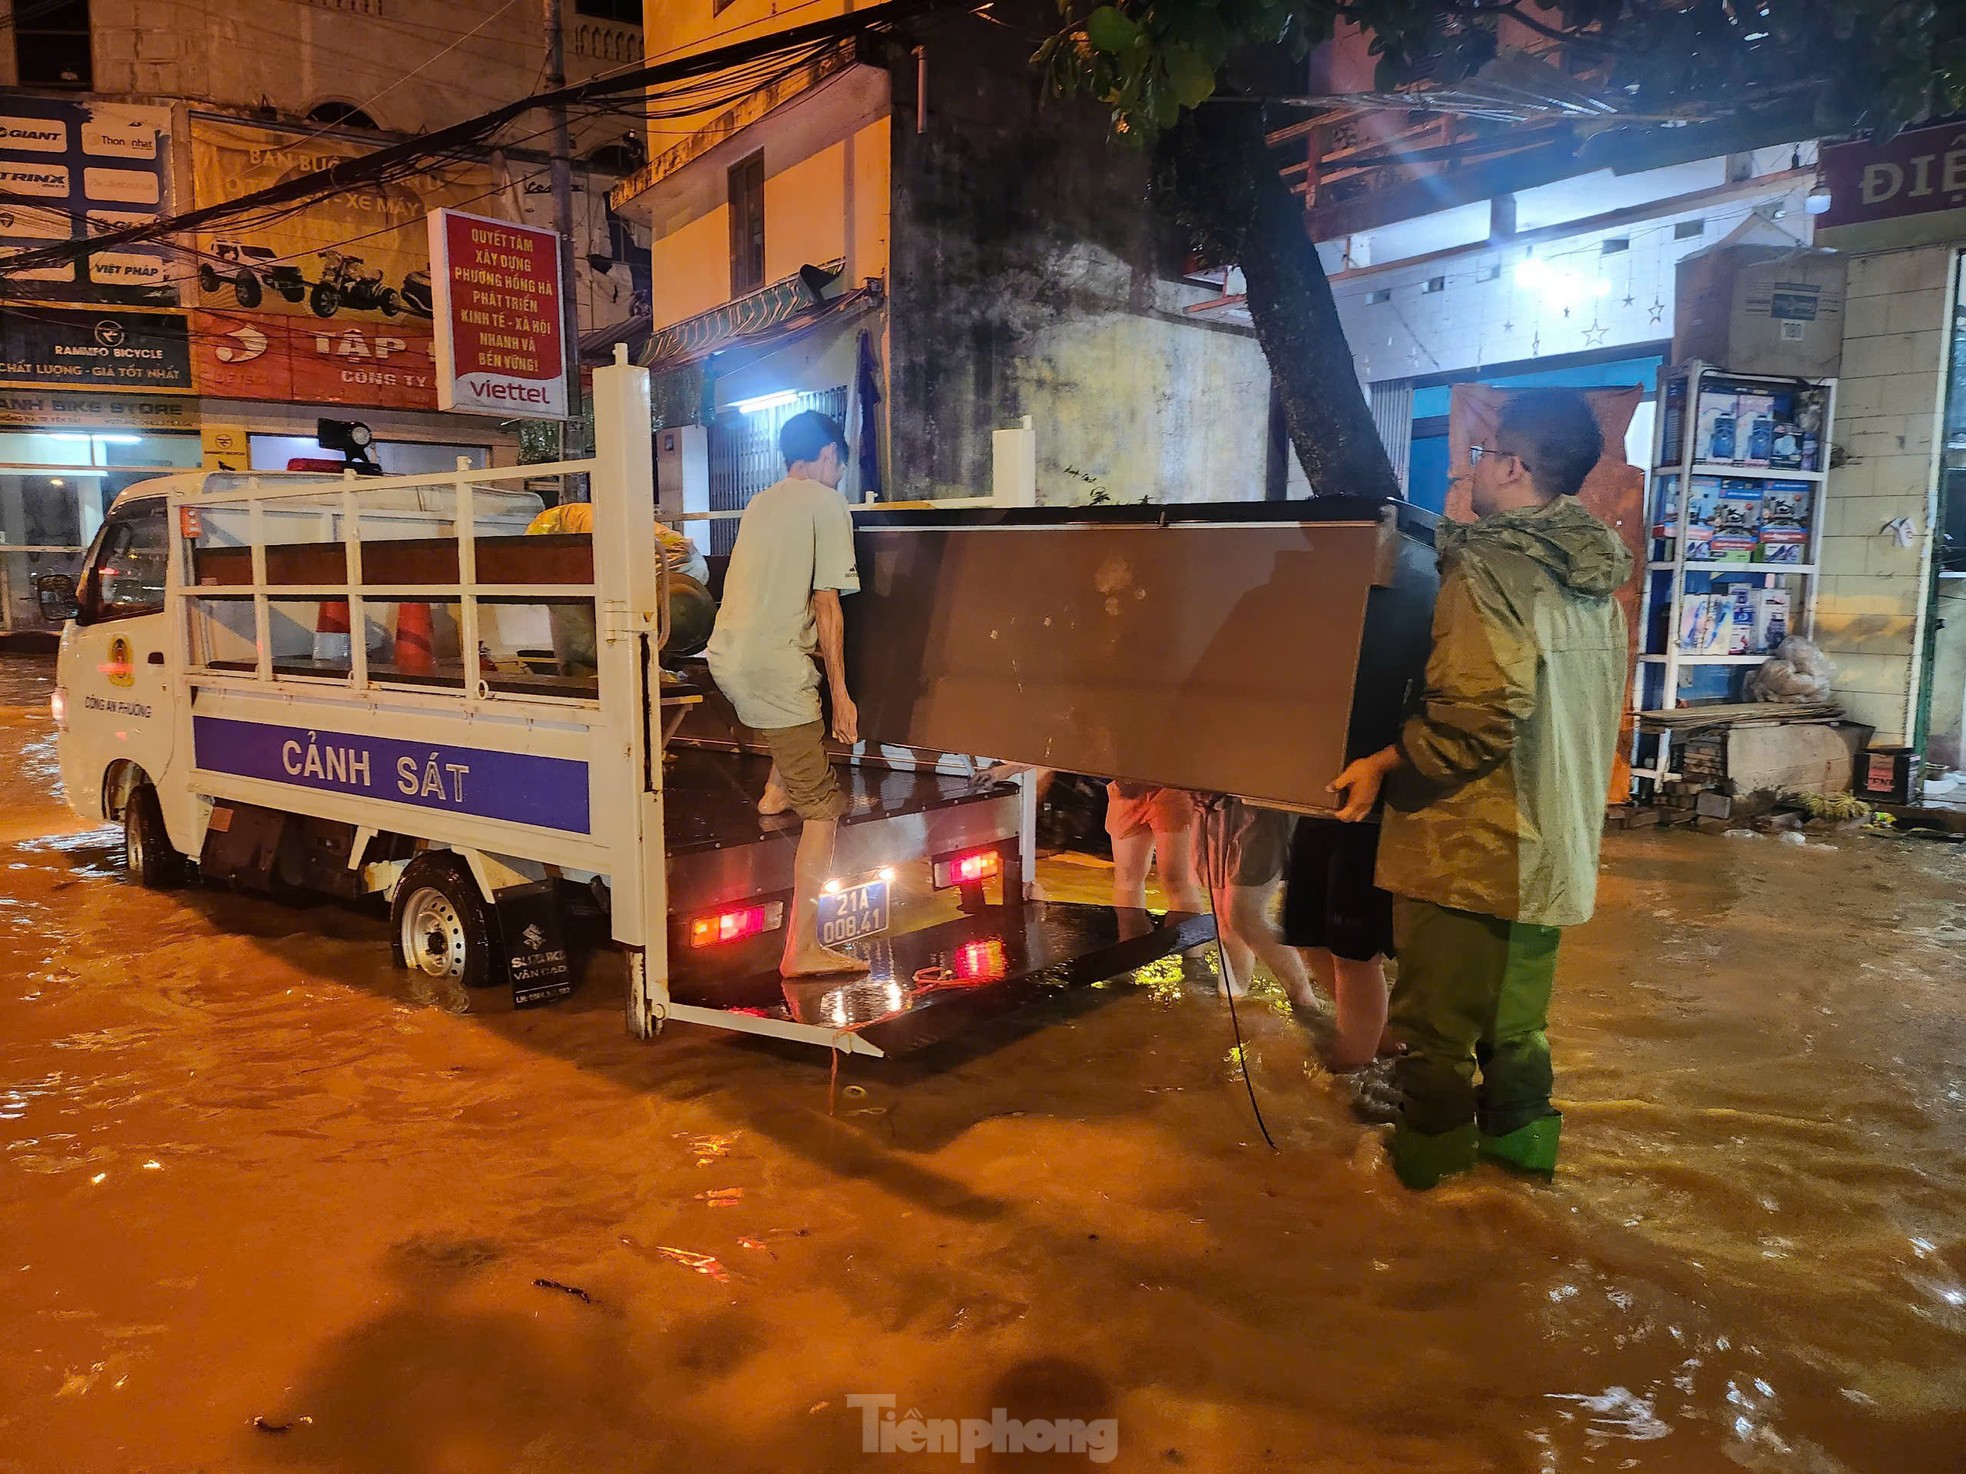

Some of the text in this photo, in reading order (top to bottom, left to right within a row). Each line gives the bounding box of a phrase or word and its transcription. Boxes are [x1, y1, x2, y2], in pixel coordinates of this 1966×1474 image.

[9, 129, 61, 142] GIANT
[0, 171, 66, 185] TRINX
[471, 228, 534, 253] QUYẾT TÂM
[123, 264, 159, 277] PHÁP
[475, 249, 533, 272] XÂY DỰNG
[454, 266, 503, 288] PHƯỜNG
[472, 289, 539, 313] PHÁT TRIỂN
[460, 308, 490, 326] KINH
[491, 311, 506, 329] TẾ
[479, 331, 520, 351] NHANH
[113, 347, 164, 360] BICYCLE
[92, 363, 116, 377] GIÁ
[118, 363, 144, 378] TỐT
[282, 730, 470, 803] CẢNH SÁT
[836, 887, 870, 916] 21A
[823, 908, 880, 944] 008.41
